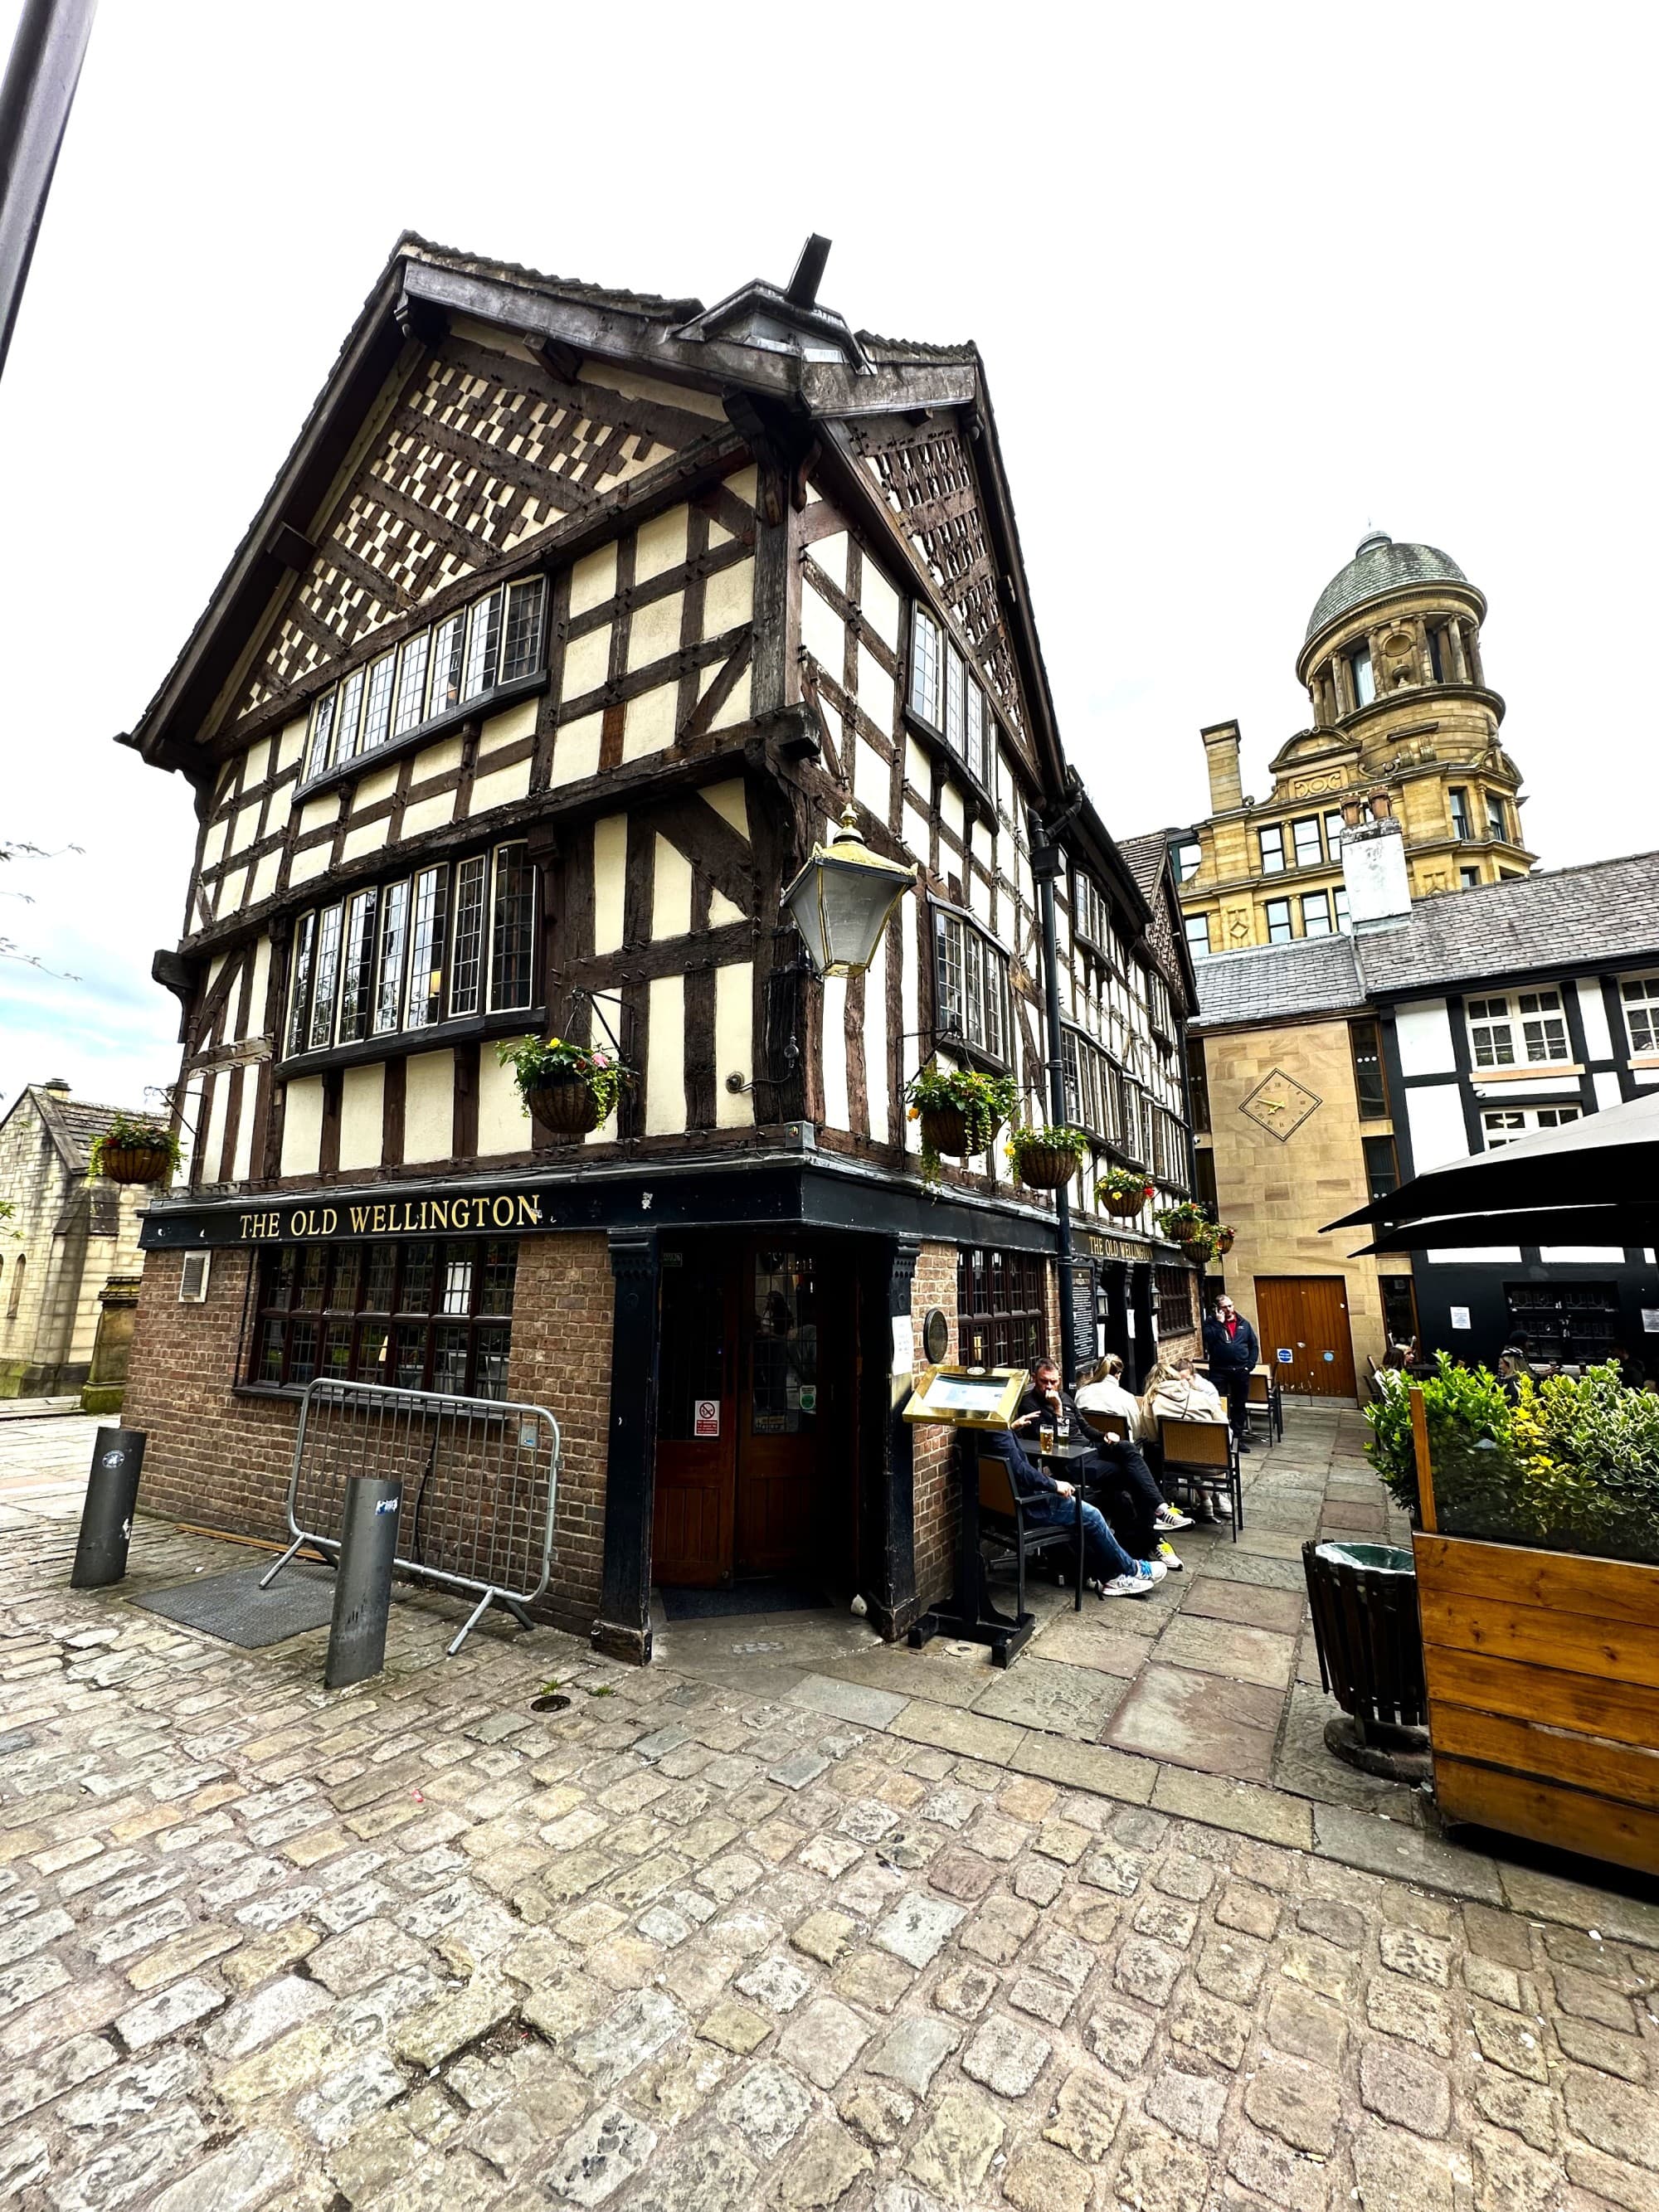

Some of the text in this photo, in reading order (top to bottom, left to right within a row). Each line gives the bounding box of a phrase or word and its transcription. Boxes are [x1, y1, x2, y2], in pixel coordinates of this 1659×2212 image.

[240, 1194, 540, 1239] THE OLD WELLINGTON
[1088, 1236, 1154, 1261] THE OLD WELLINGTON
